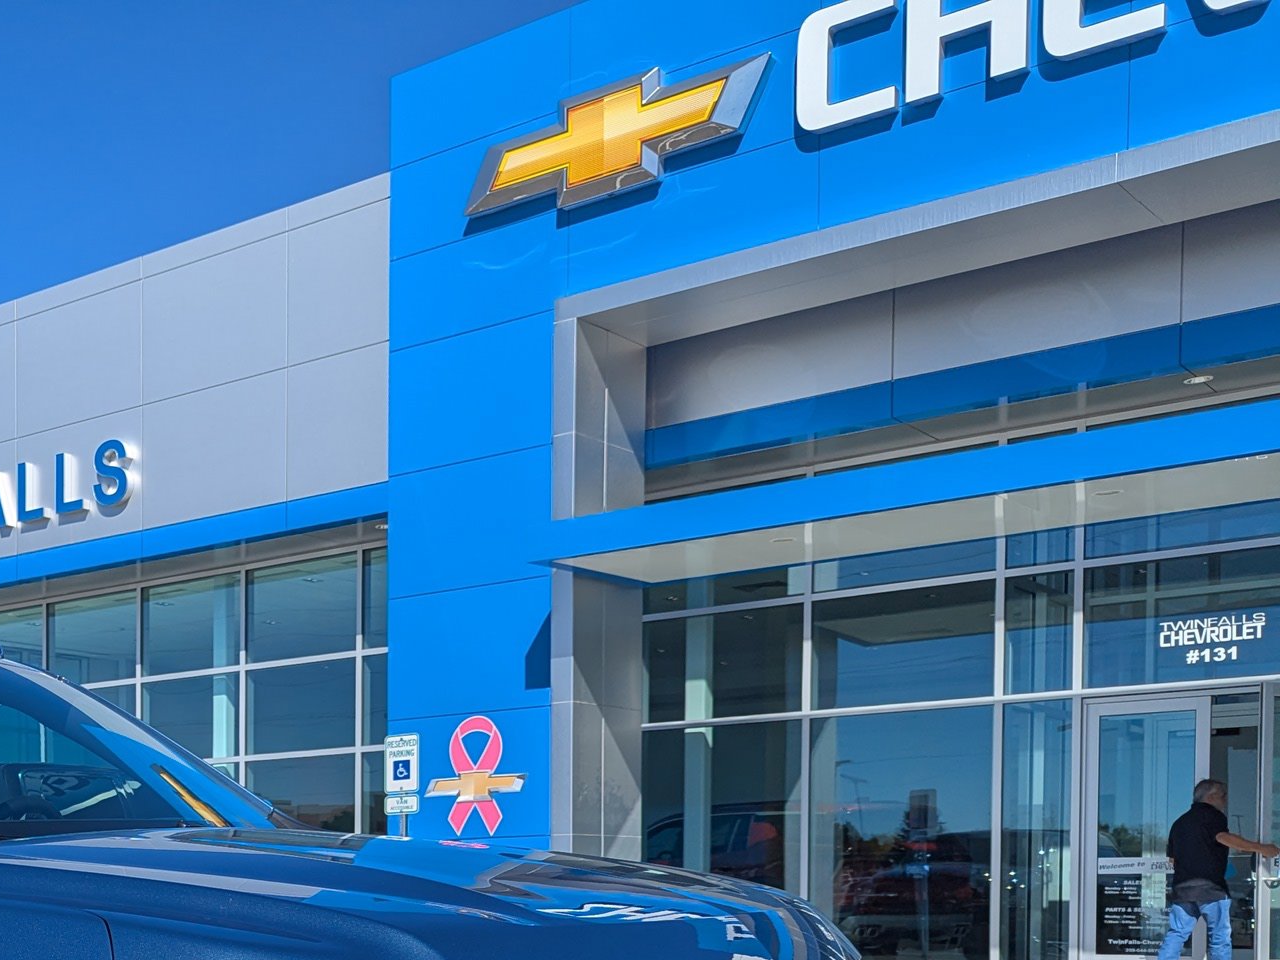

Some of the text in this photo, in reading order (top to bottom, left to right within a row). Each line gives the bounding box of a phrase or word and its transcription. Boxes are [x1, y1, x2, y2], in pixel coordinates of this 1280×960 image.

[1160, 612, 1265, 631] TWINFALLS
[1160, 622, 1265, 647] CHEVROLET
[1186, 646, 1237, 664] #131
[387, 739, 417, 748] RESERVED
[389, 750, 415, 758] PARKING
[1099, 862, 1135, 870] Welcome
